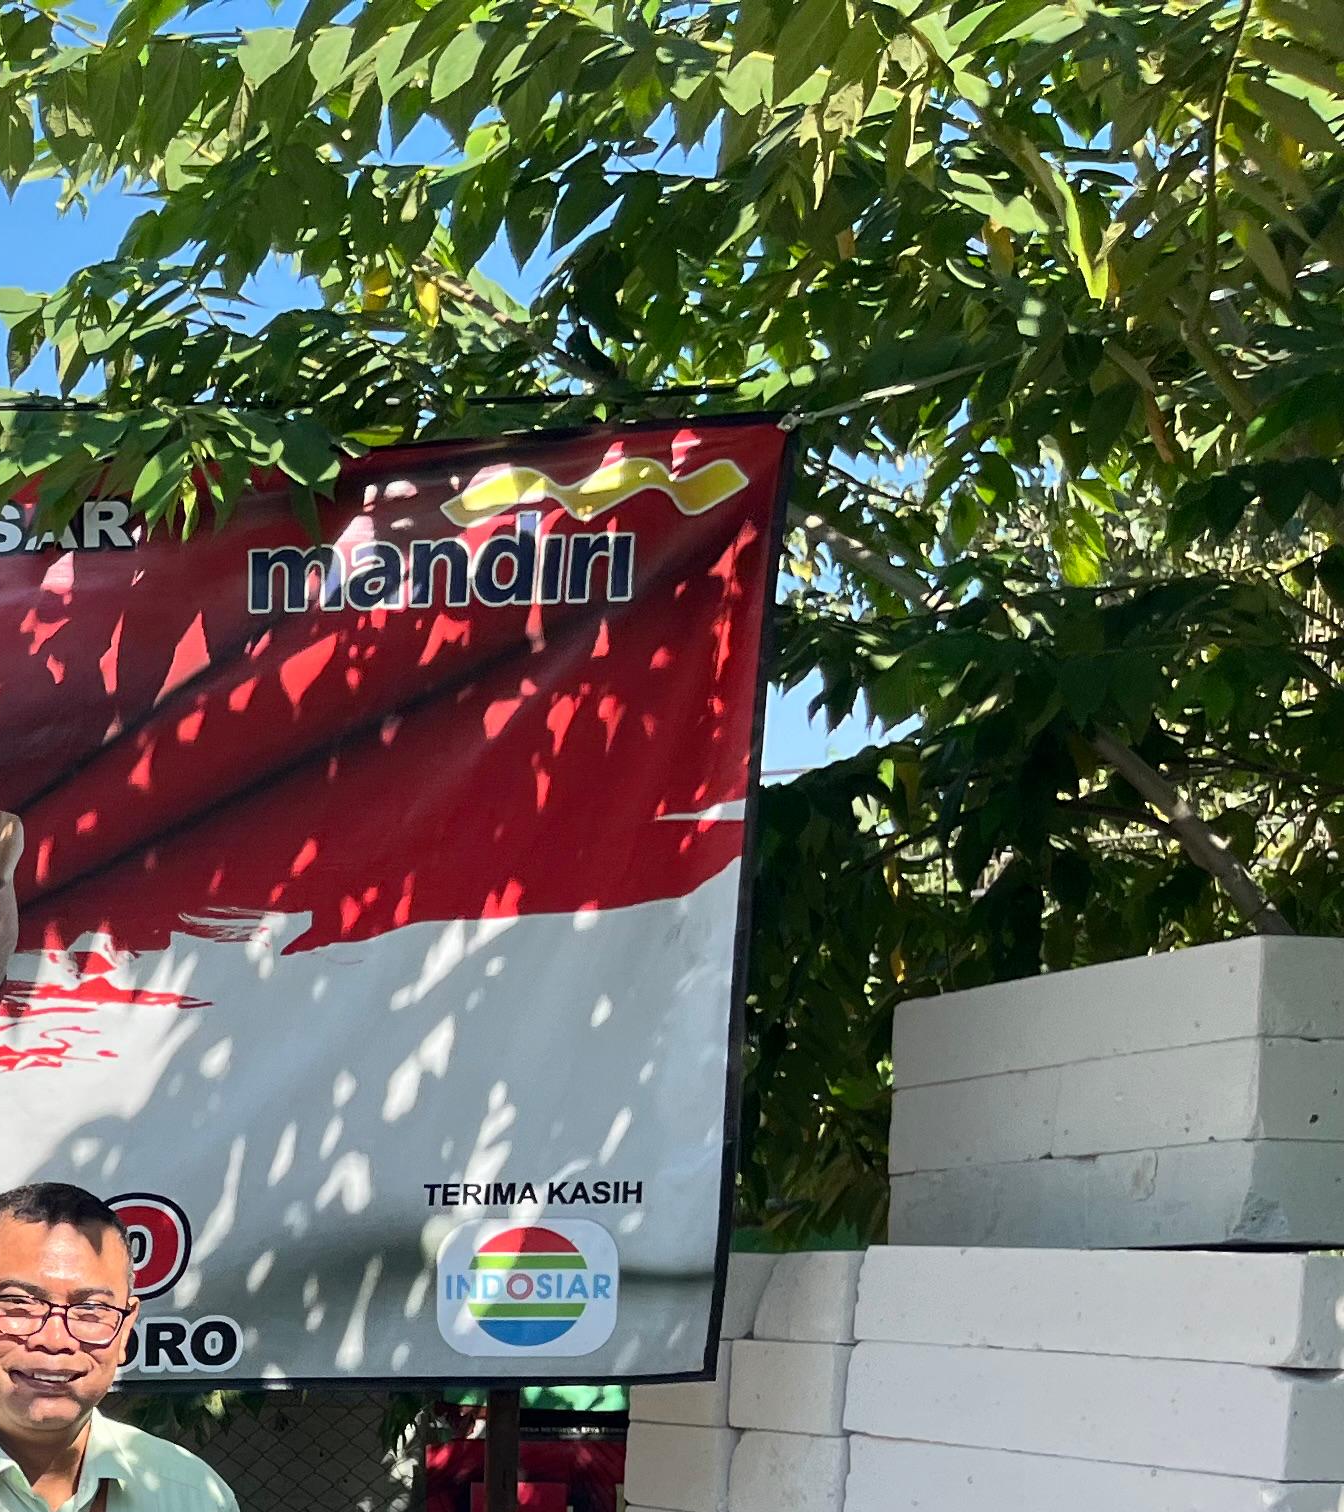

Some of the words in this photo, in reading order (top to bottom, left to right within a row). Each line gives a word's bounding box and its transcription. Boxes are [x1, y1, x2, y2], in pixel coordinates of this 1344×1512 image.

[248, 511, 635, 614] mandiri
[424, 1182, 538, 1206] TERIMA
[548, 1180, 643, 1205] KASIH
[444, 1273, 611, 1301] INDOSIAR
